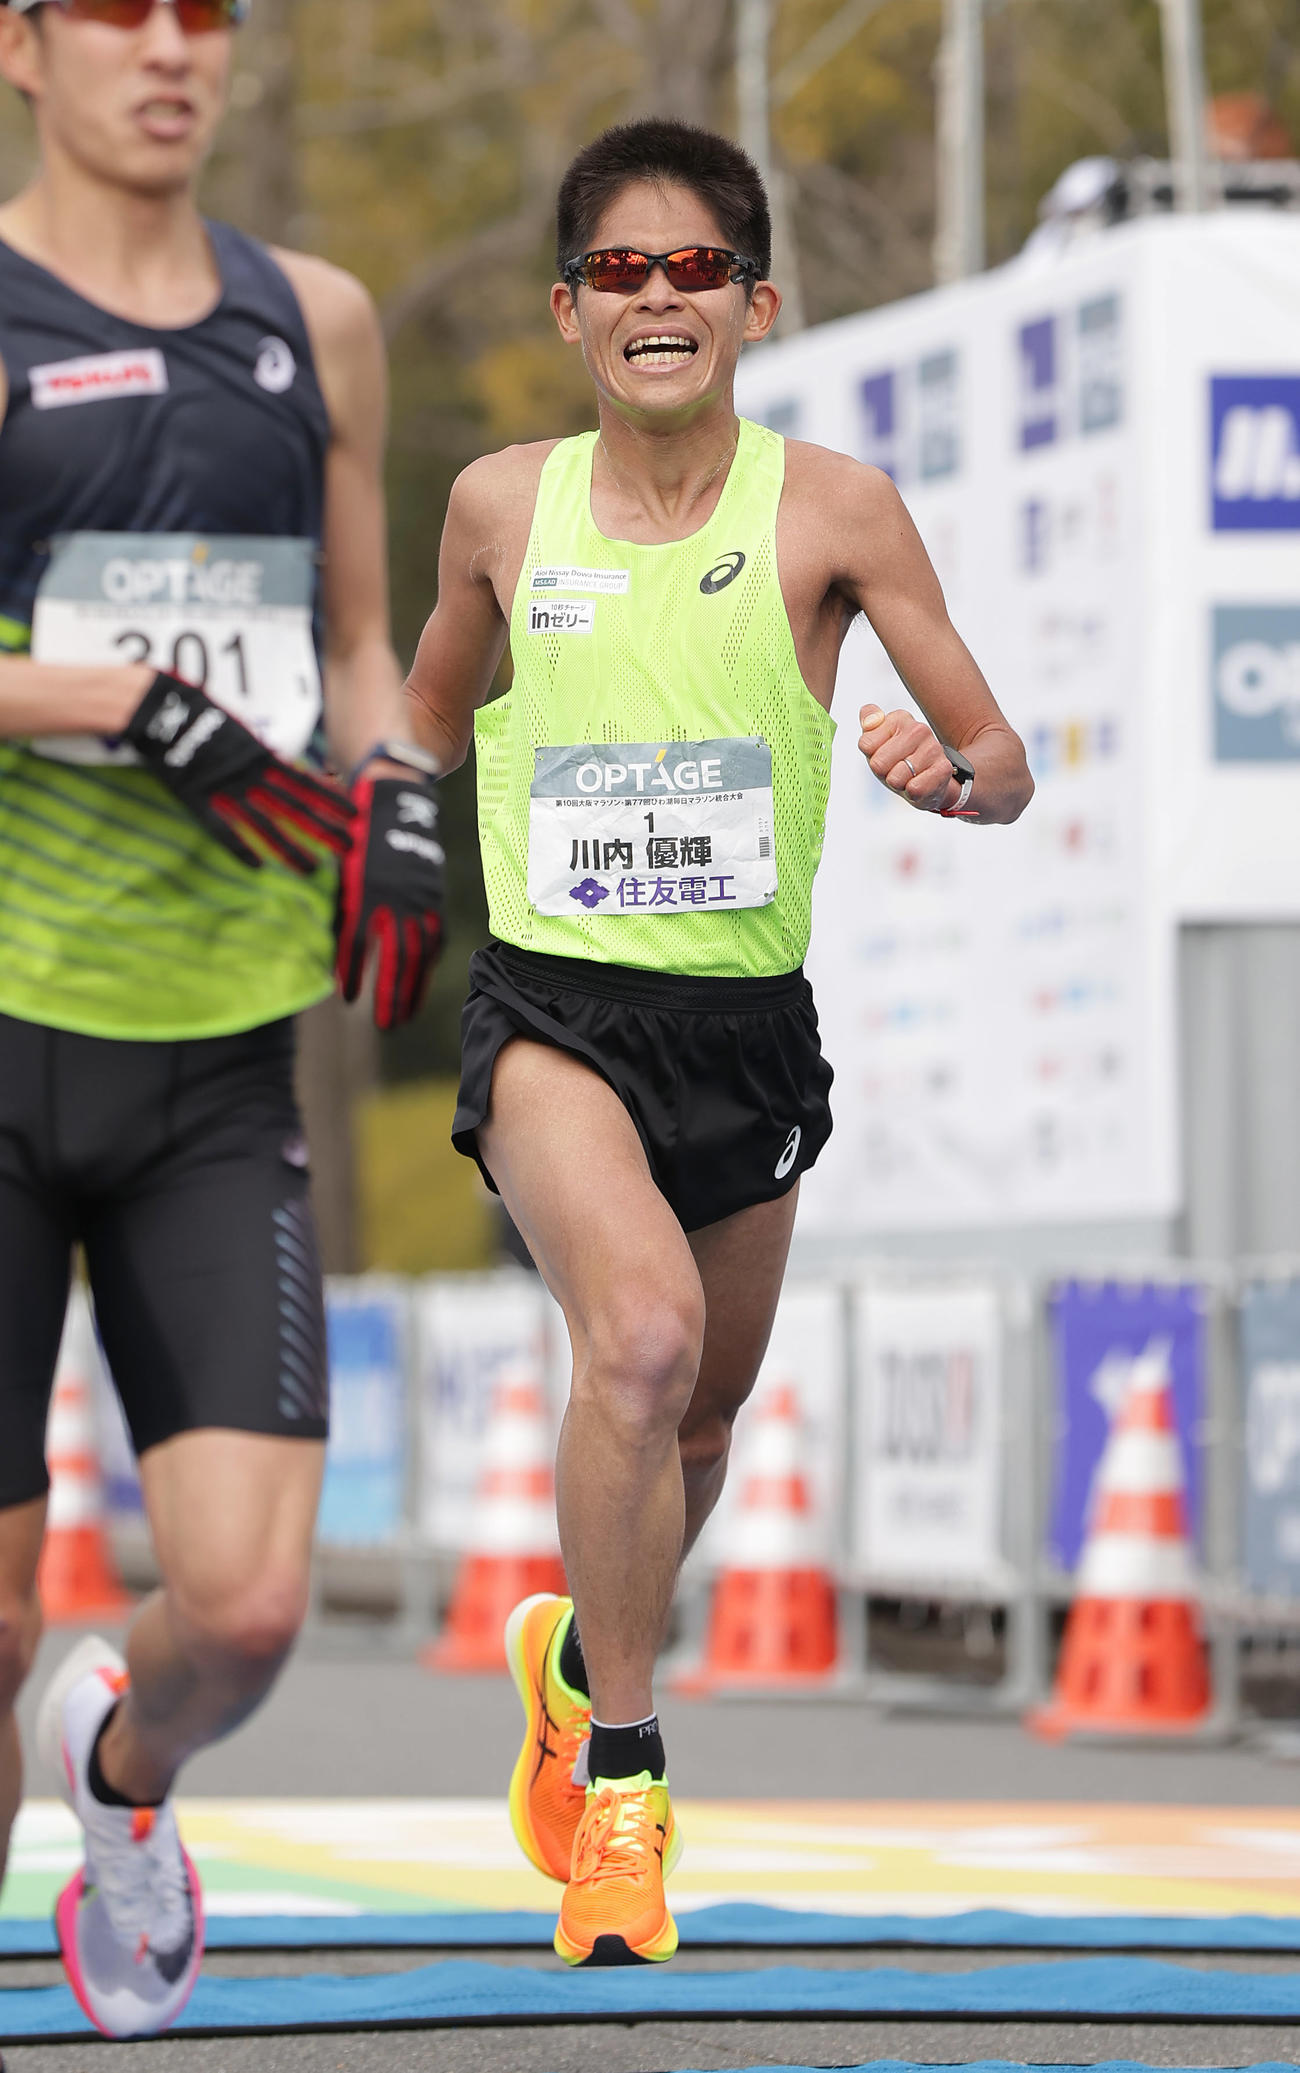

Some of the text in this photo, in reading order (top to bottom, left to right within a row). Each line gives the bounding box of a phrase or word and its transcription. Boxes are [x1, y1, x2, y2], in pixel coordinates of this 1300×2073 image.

[575, 751, 723, 793] OPTAGE
[643, 812, 655, 833] 1
[569, 836, 712, 871] 川内 優輝
[617, 875, 737, 908] 住友電工
